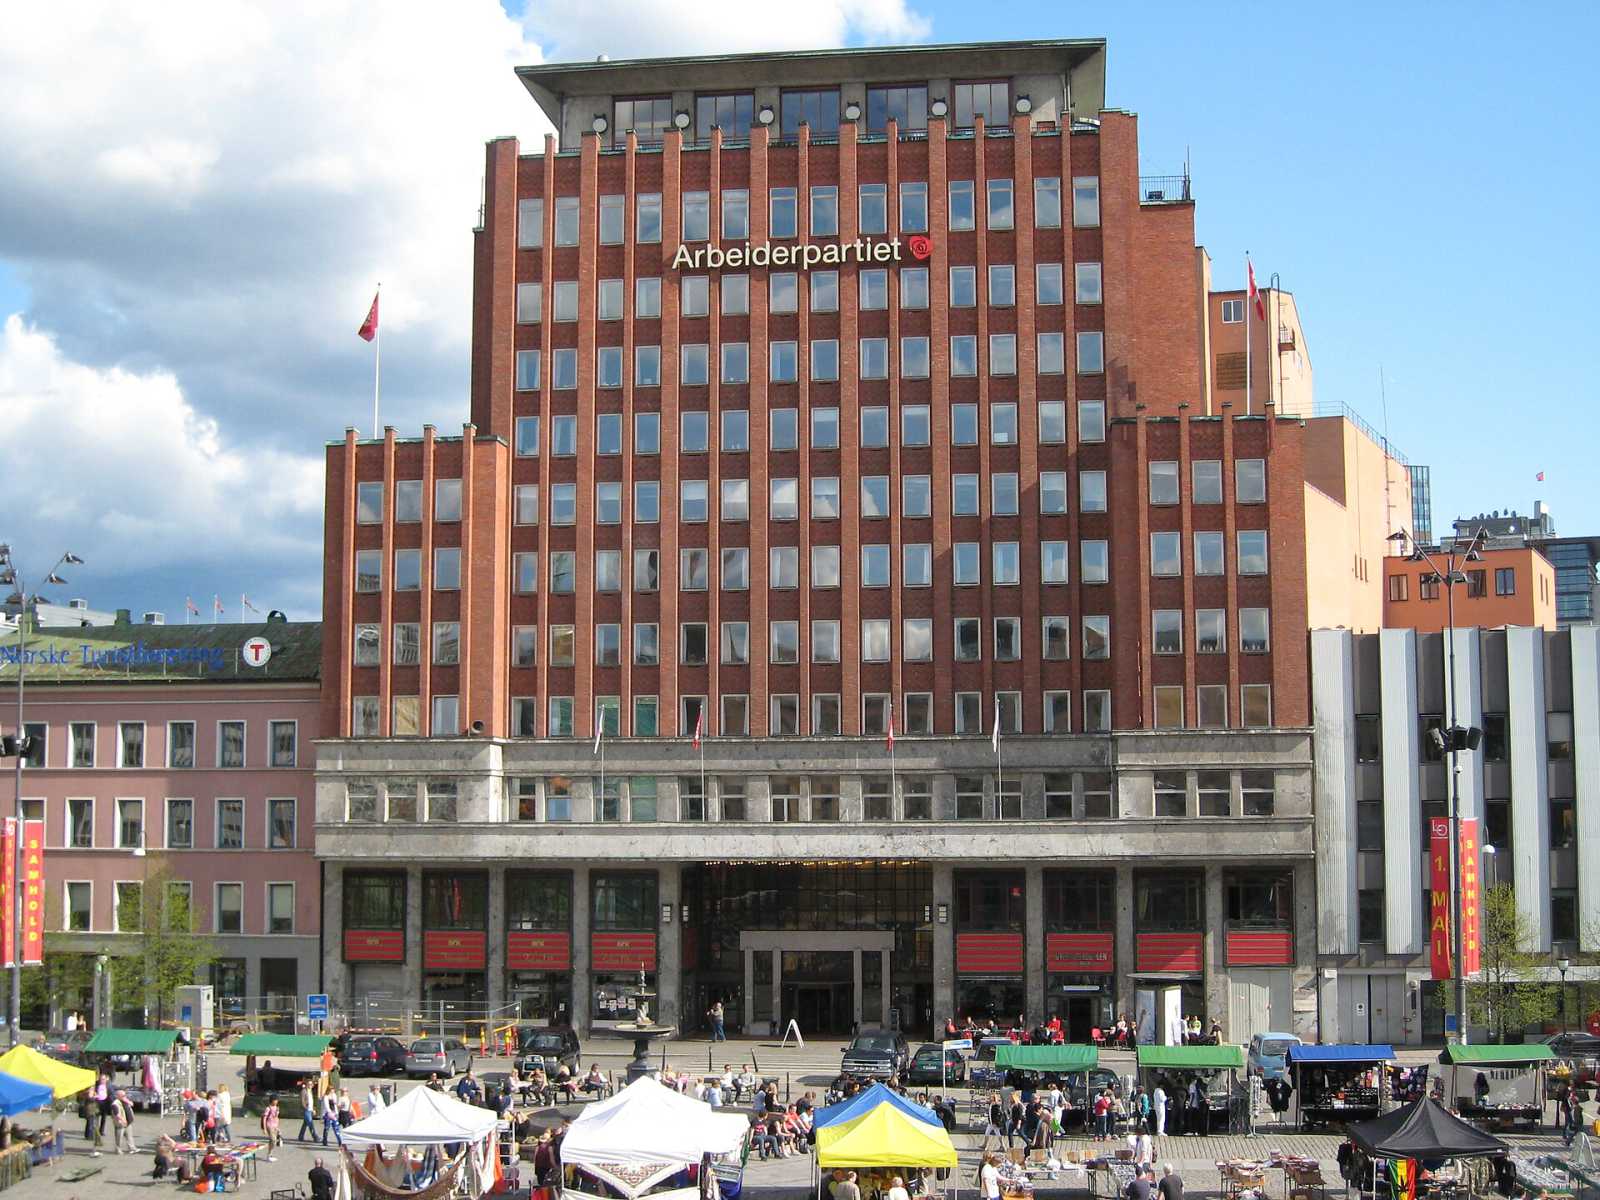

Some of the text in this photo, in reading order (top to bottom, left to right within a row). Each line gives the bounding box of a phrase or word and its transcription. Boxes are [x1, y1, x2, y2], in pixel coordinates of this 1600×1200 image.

[671, 237, 902, 270] Arbeiderpartiet
[0, 643, 71, 664] Norske
[250, 644, 265, 661] T
[1432, 819, 1448, 837] LO
[28, 839, 39, 942] SAMHOLD
[1432, 855, 1447, 956] 1. MAI
[1465, 839, 1476, 951] SAMHOLD
